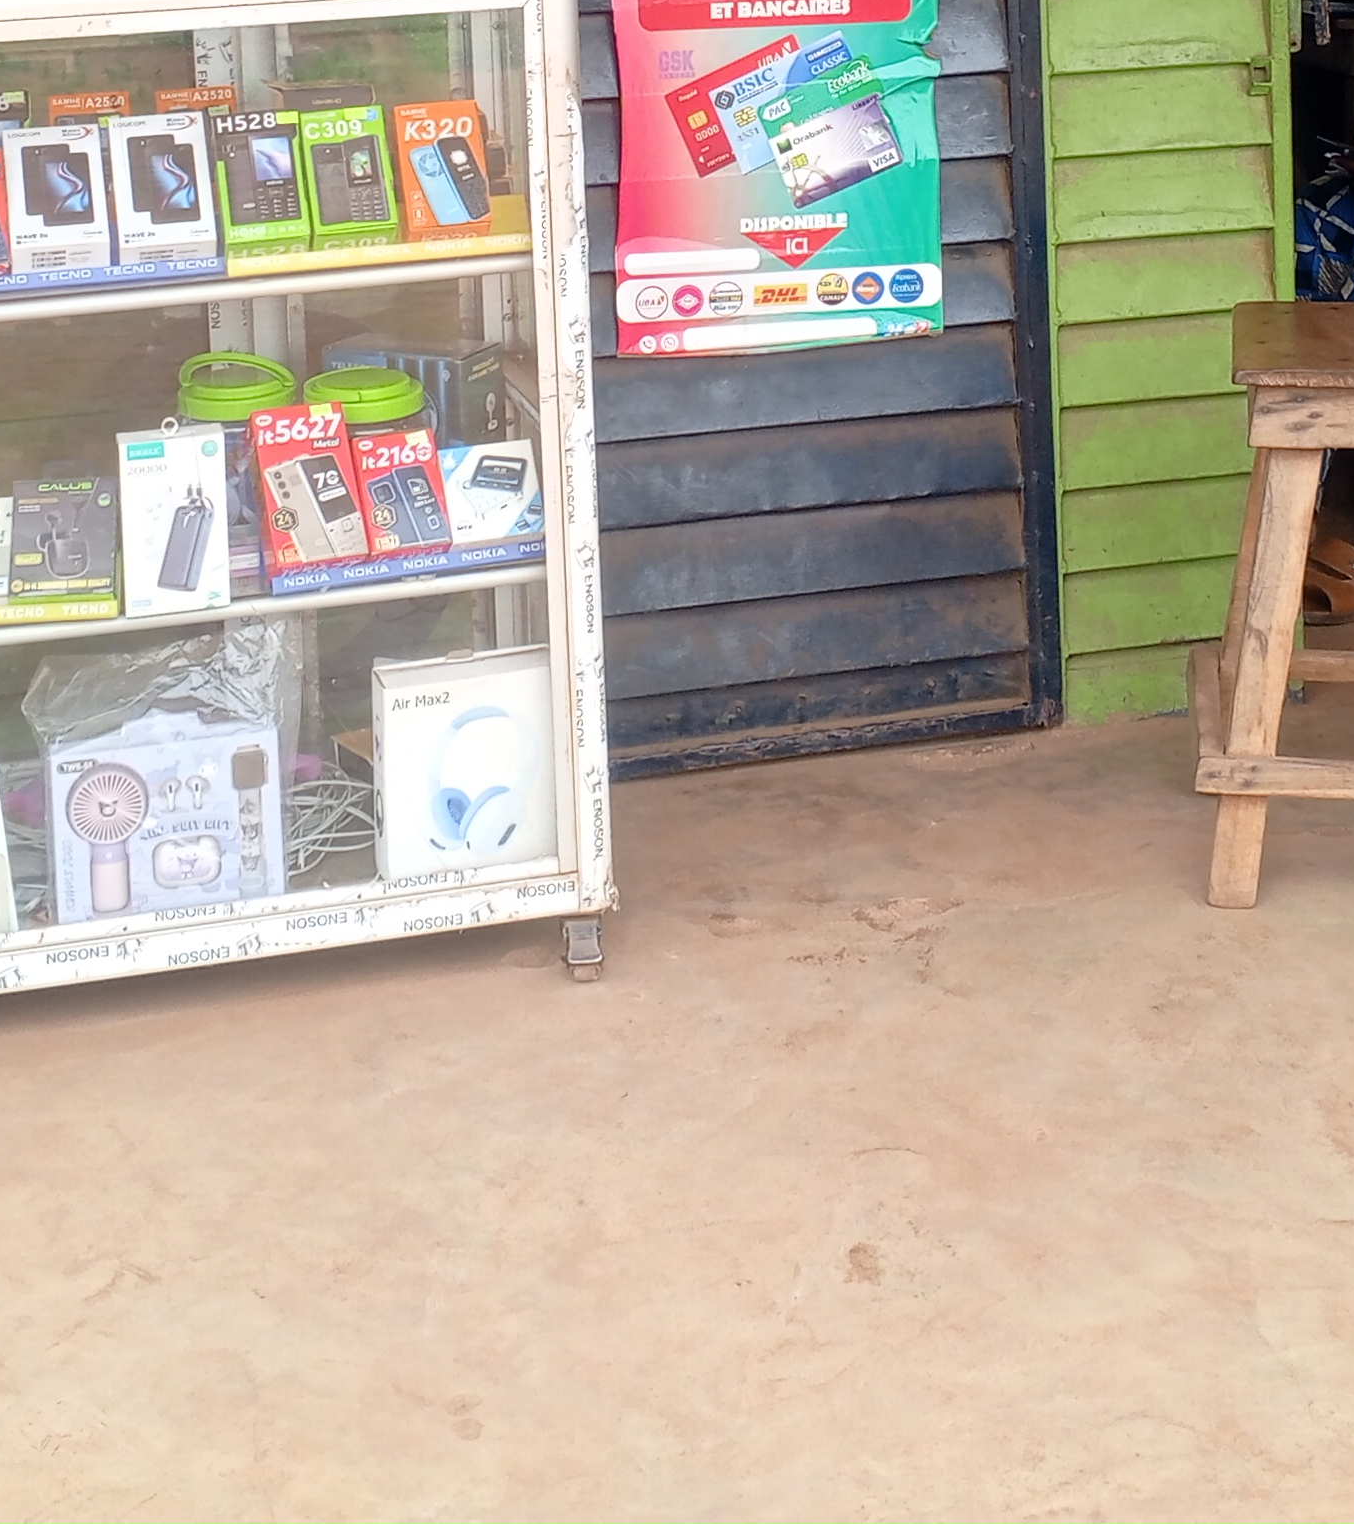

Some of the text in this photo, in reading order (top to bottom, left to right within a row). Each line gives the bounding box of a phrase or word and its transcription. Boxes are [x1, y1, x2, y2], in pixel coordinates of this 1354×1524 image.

[710, 2, 734, 20] ET
[658, 50, 695, 72] GSK
[810, 52, 849, 77] CLASSIC
[732, 67, 776, 97] BSIC
[827, 60, 871, 94] Ecobank
[216, 111, 277, 133] H528
[304, 119, 364, 140] C309
[404, 117, 473, 142] K320
[792, 123, 834, 146] Orabank
[872, 151, 897, 168] VISA
[740, 212, 849, 233] DISPONIBLE
[424, 239, 473, 253] NOKIA
[784, 237, 809, 256] ICI
[38, 269, 92, 282] TECNO
[166, 258, 218, 270] TECNO
[760, 286, 800, 304] DHL
[257, 412, 342, 447] it5627
[312, 437, 340, 450] Metal
[283, 547, 508, 589] NOKIA NOKIA
[62, 603, 109, 616] TECNO
[391, 690, 451, 712] Air Max2
[516, 879, 576, 900] ENOSON
[45, 945, 110, 965] ENOSON
